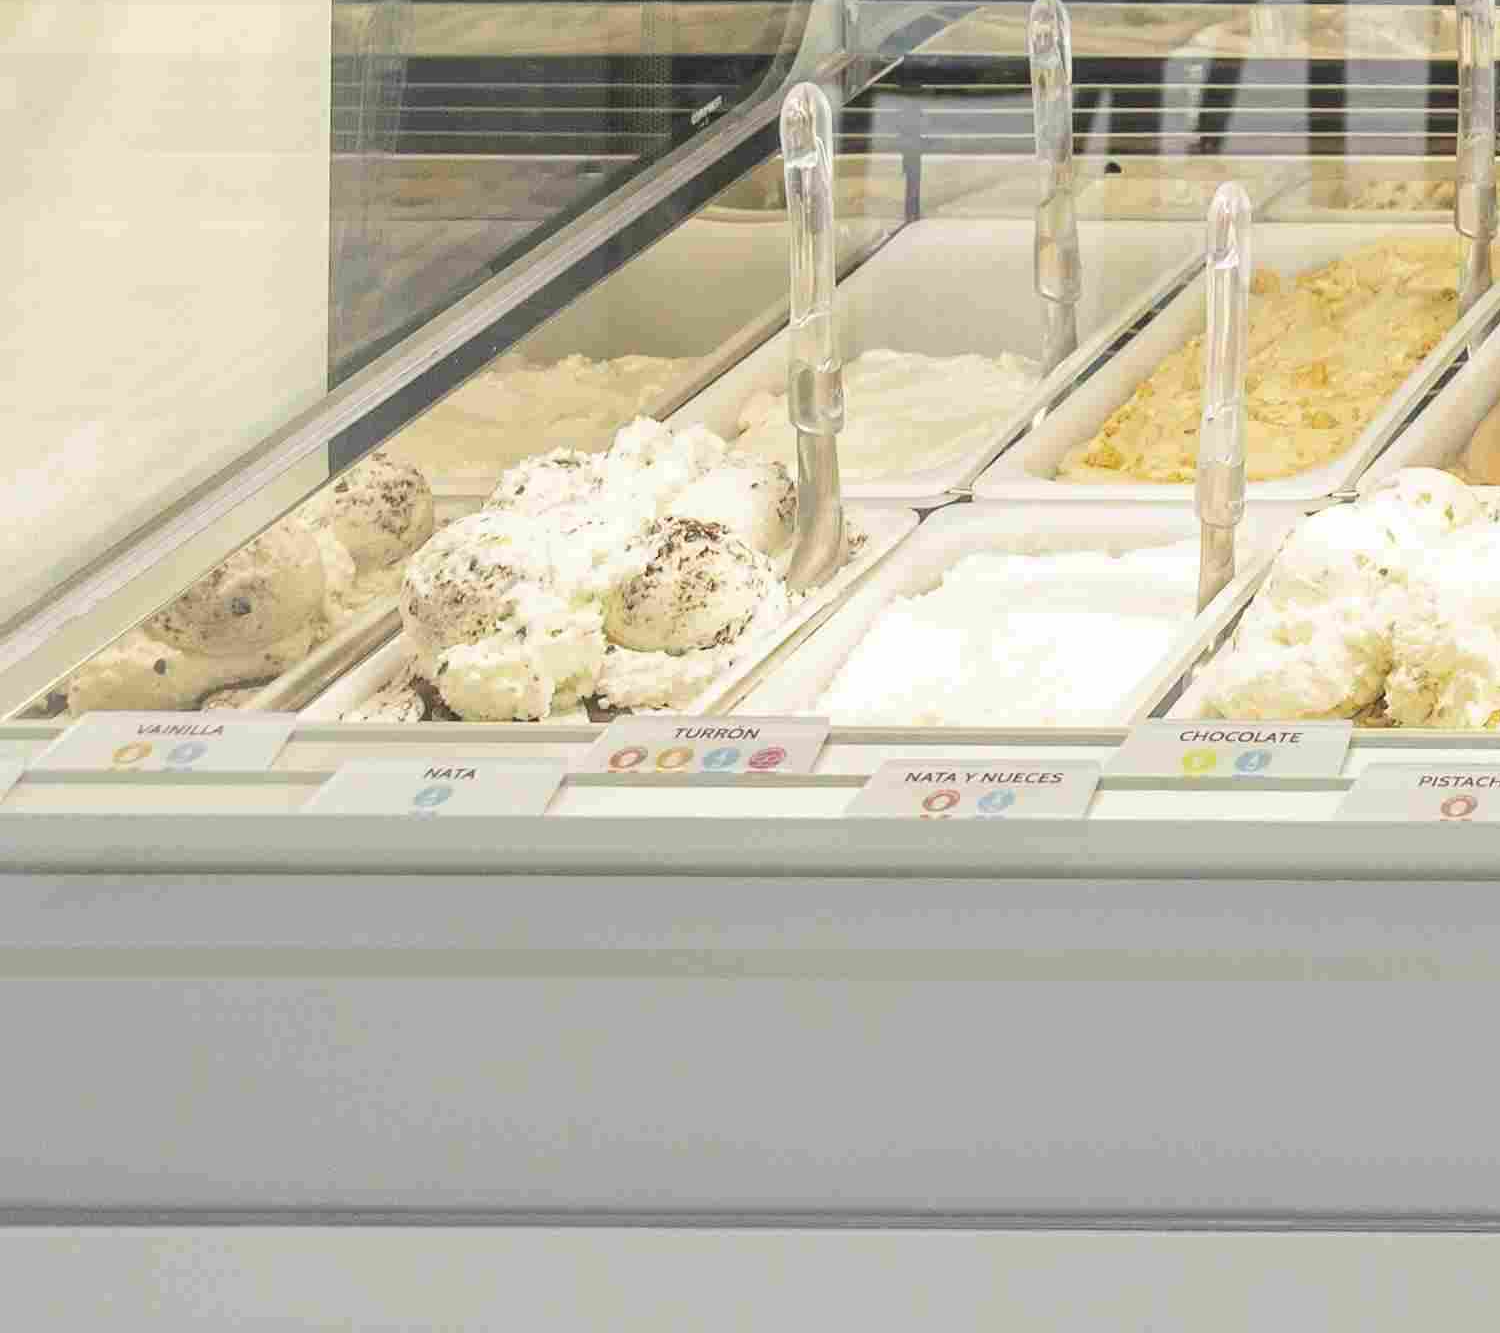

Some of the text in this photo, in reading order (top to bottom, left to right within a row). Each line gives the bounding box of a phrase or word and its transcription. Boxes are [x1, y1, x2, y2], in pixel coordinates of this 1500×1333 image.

[136, 724, 225, 736] VAINILLA
[674, 724, 761, 741] TURRÓN
[1179, 730, 1305, 743] CHOCOLATE
[424, 767, 477, 780] NATA
[904, 772, 957, 783] NATA
[981, 772, 1065, 784] NUECES
